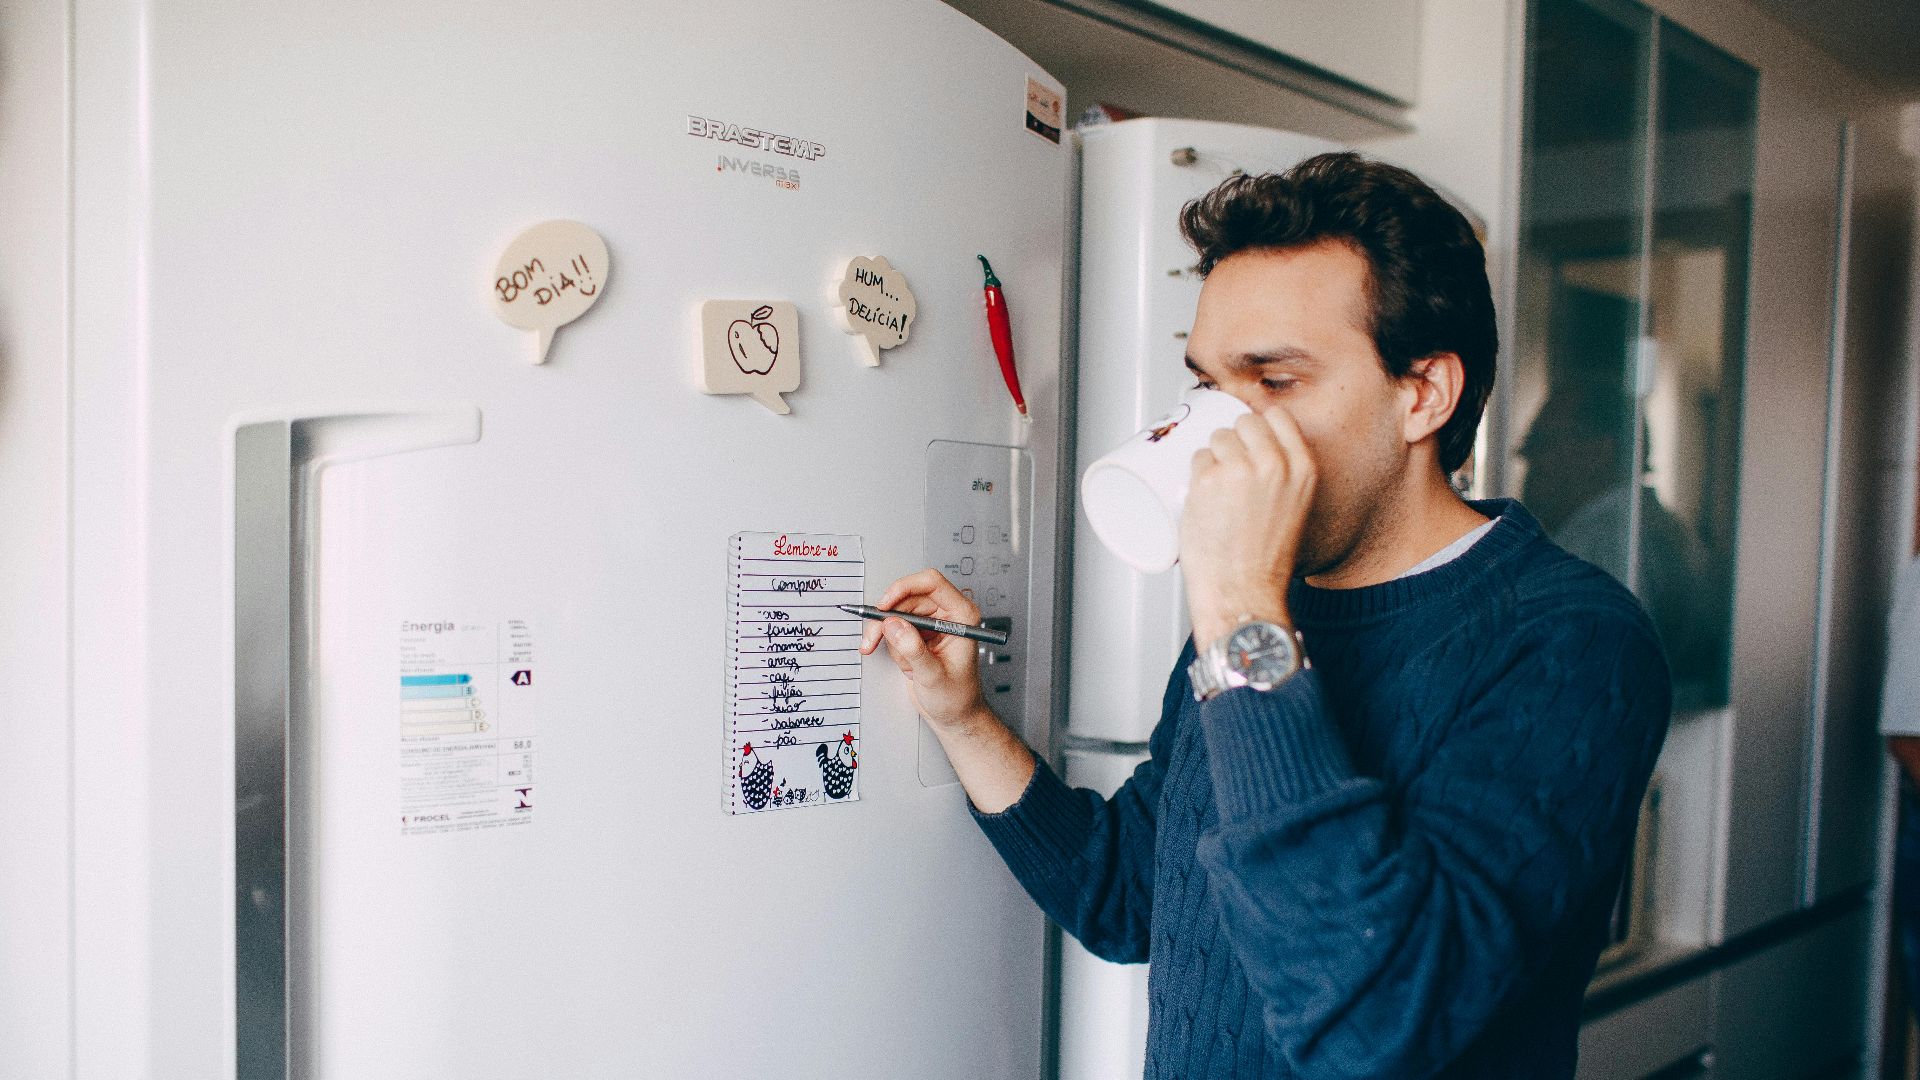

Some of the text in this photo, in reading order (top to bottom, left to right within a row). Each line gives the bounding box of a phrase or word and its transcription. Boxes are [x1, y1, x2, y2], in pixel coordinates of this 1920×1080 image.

[687, 115, 826, 161] BRASTEMP
[495, 257, 545, 303] BOM
[773, 534, 839, 557] Lembre-se
[402, 621, 455, 634] Energia
[517, 671, 531, 686] A
